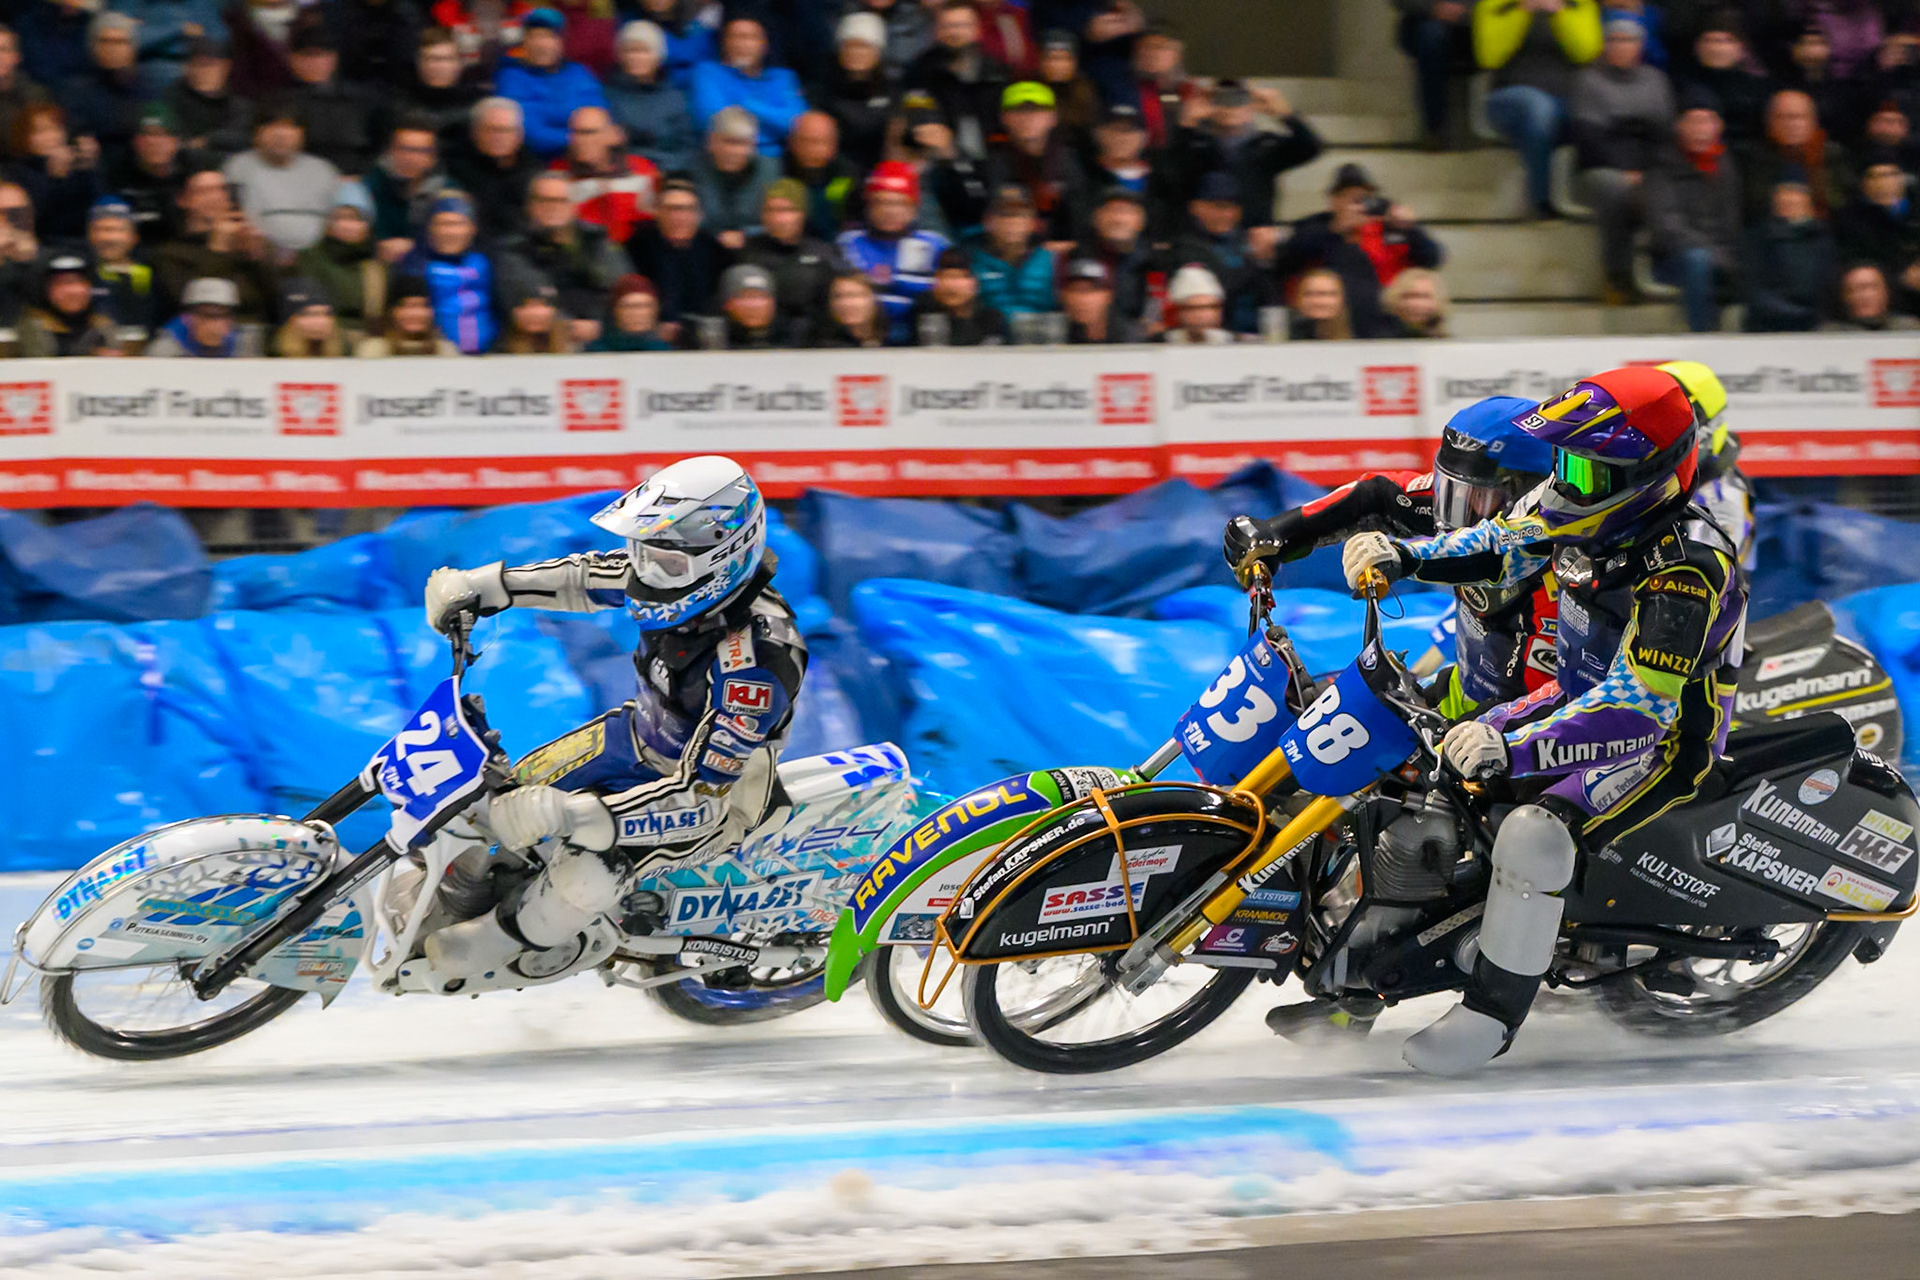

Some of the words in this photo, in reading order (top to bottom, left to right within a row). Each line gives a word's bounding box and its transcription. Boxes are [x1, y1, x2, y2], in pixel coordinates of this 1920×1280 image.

[1638, 647, 1691, 674] WINZZ
[1199, 655, 1277, 743] 33
[1736, 668, 1872, 713] kugelmann
[1185, 721, 1212, 753] FIM
[1297, 684, 1371, 766] 88
[395, 710, 463, 797] 24
[1283, 738, 1304, 764] FIM
[624, 806, 706, 838] DYNASET
[1742, 779, 1841, 846] Kunemann
[854, 784, 1027, 911] RAVENOL
[1238, 831, 1320, 893] Kunemann
[1738, 832, 1782, 859] Stefan
[1636, 851, 1721, 899] KULTSTOFF
[1724, 845, 1820, 896] KAPSNER
[677, 878, 812, 923] DYNASET
[684, 940, 758, 960] KONEISTUS
[1000, 920, 1110, 947] kugelmann
